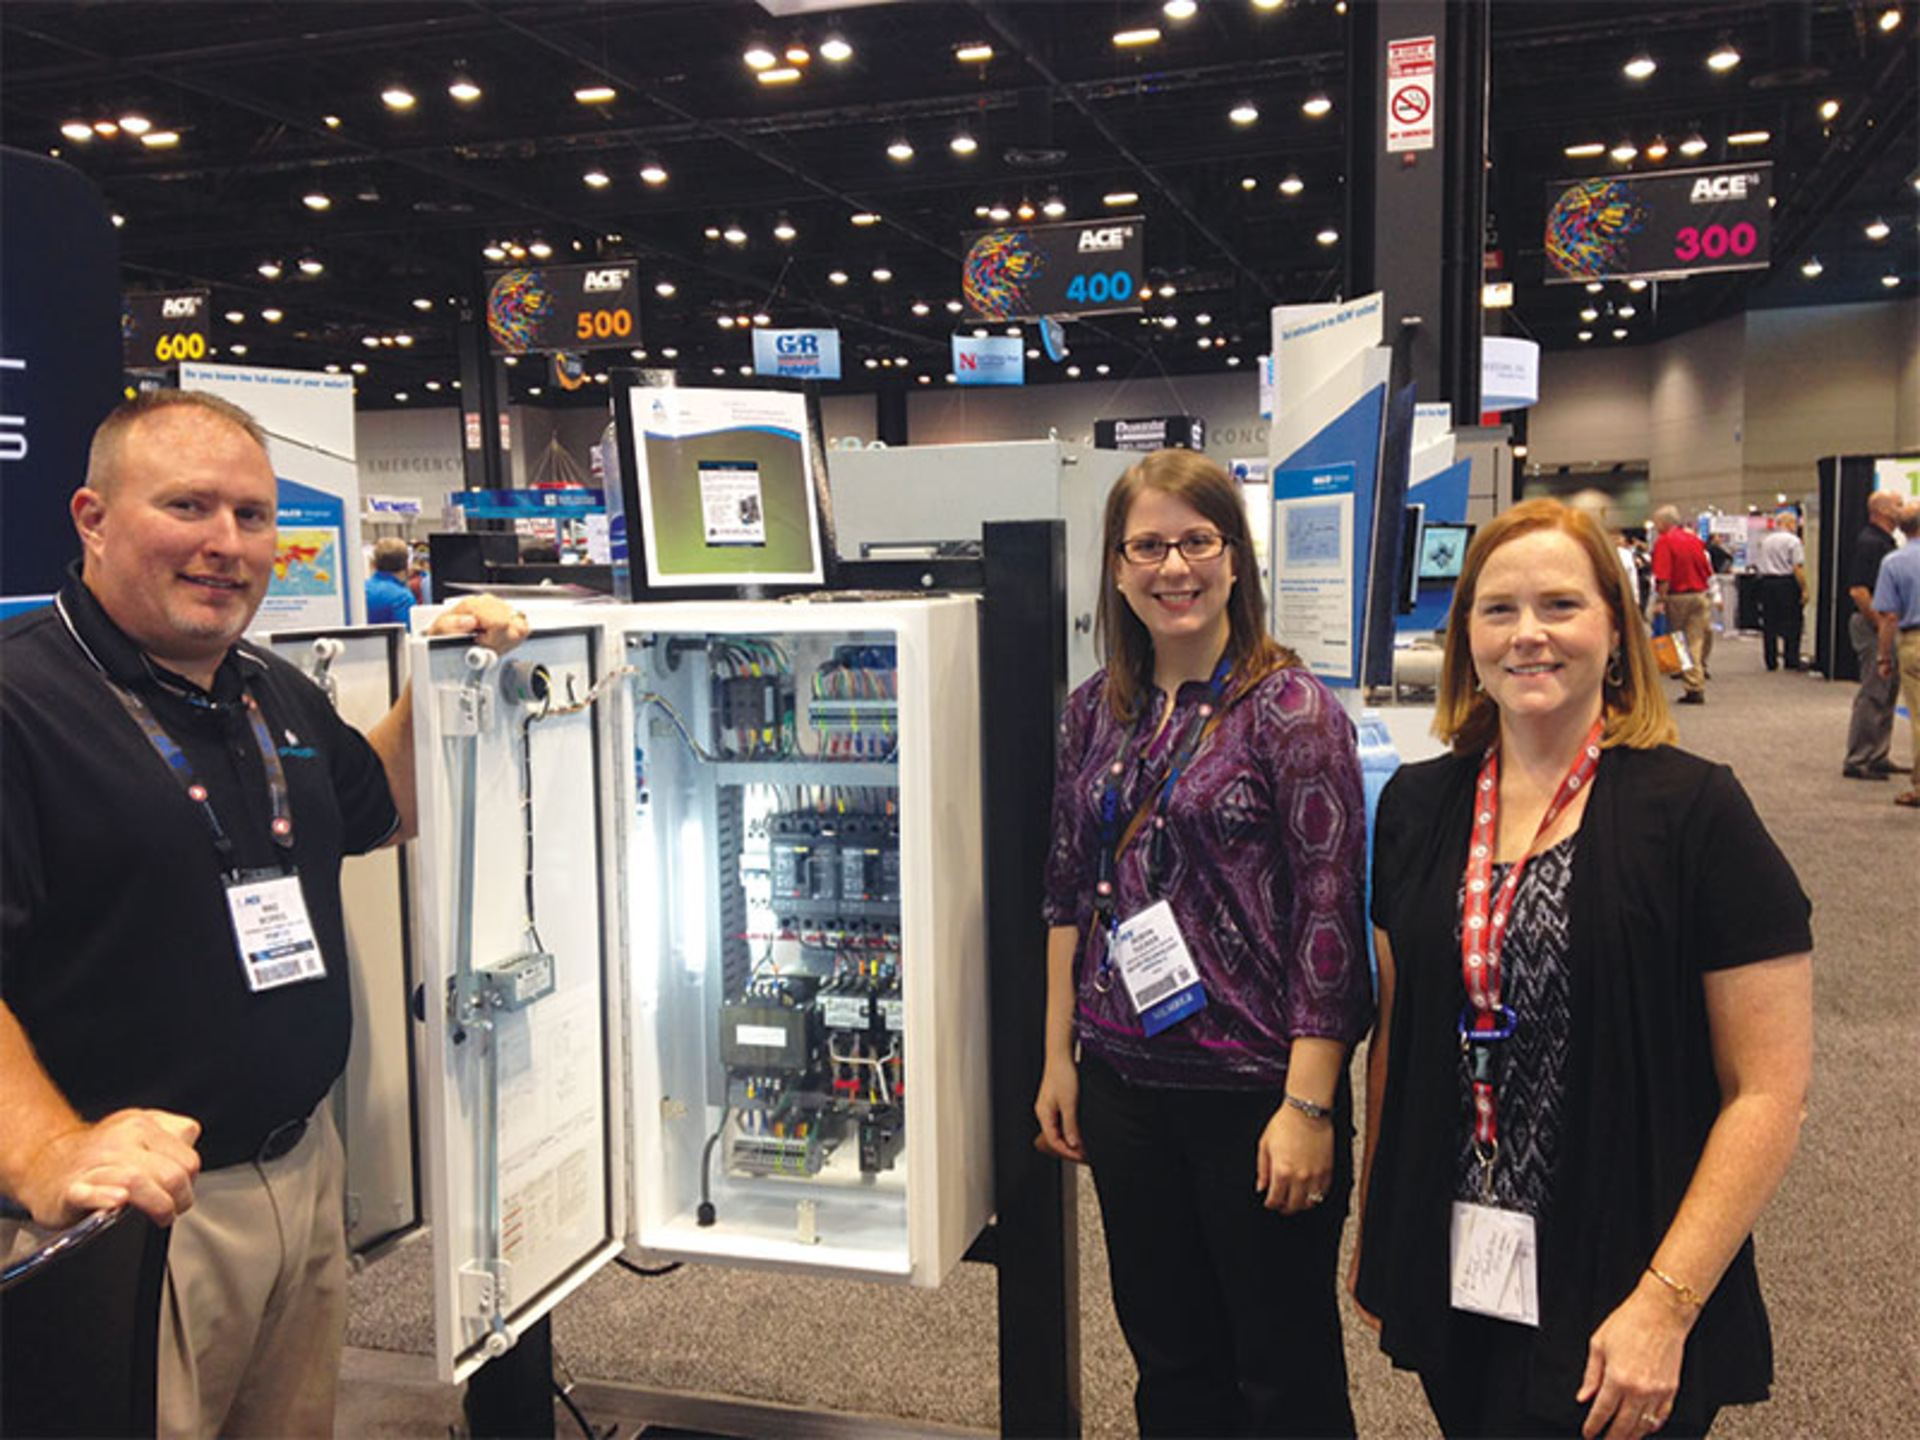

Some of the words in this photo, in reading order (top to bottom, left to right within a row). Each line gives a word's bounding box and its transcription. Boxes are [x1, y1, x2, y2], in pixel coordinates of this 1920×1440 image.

[1675, 222, 1757, 261] 300
[1066, 271, 1133, 302] 400
[577, 309, 632, 339] 500
[156, 333, 205, 361] 600
[960, 352, 977, 371] N
[368, 457, 462, 473] EMERGENCY
